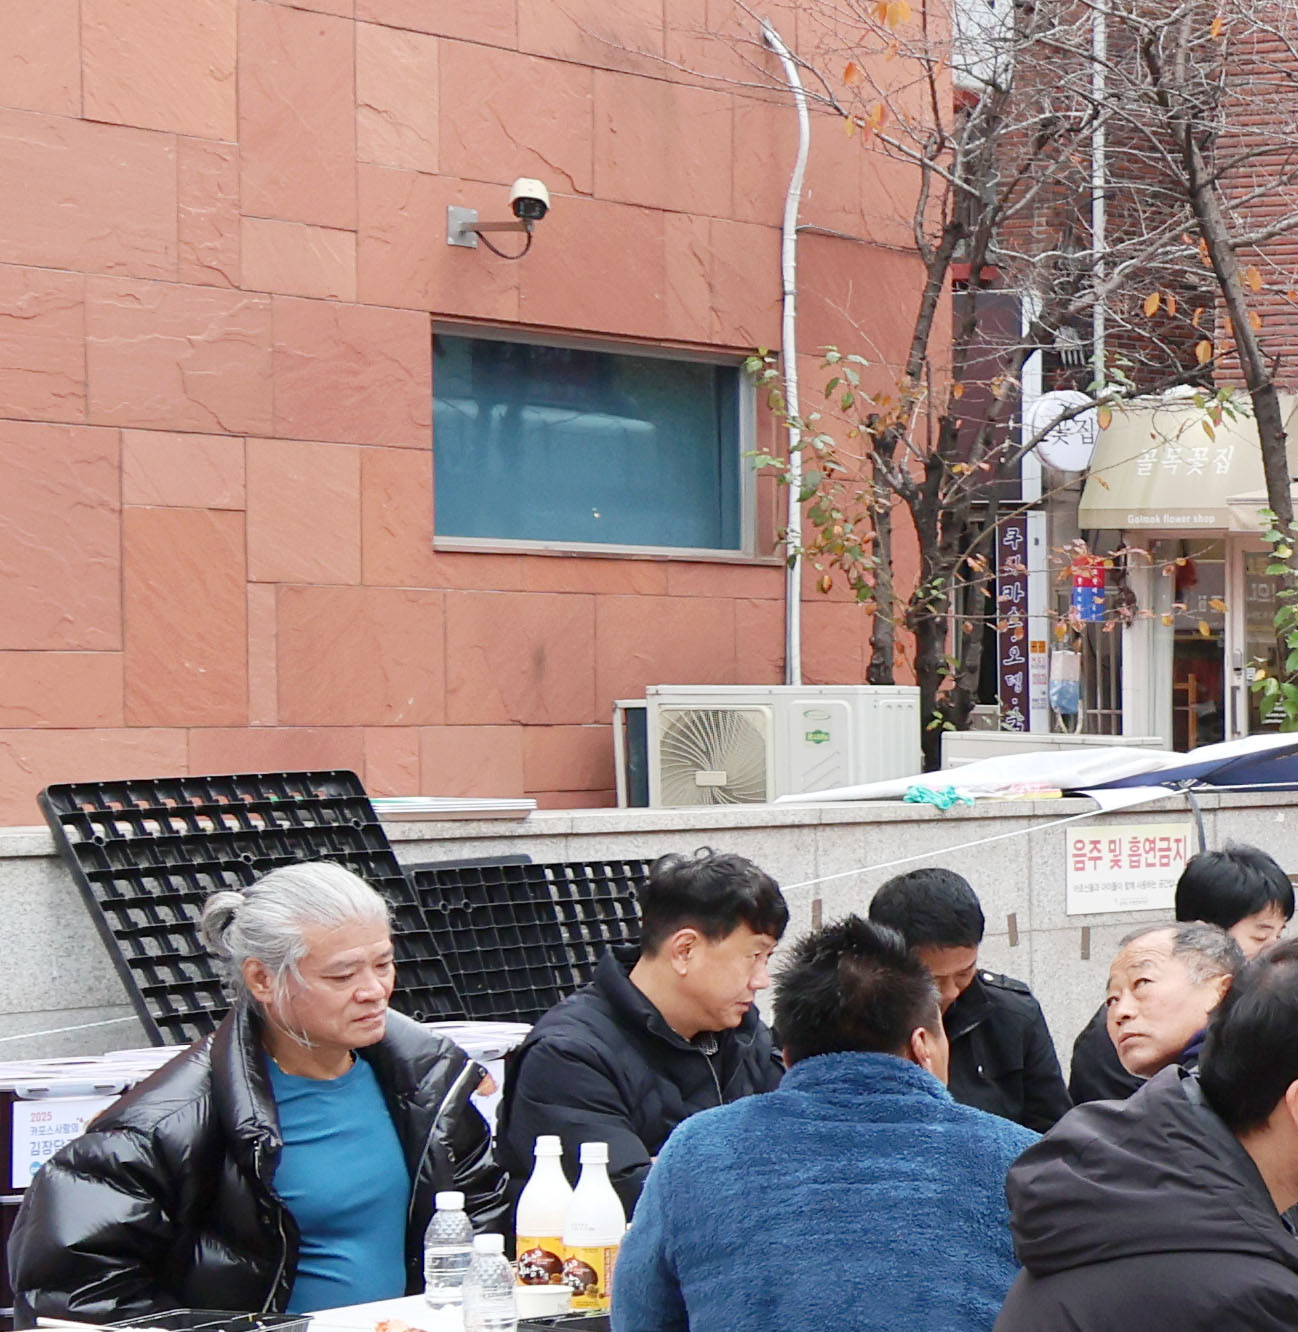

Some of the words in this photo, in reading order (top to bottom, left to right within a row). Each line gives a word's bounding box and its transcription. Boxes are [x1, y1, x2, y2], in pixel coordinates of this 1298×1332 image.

[1128, 513, 1161, 525] Golmok
[1163, 513, 1191, 525] flower
[1193, 513, 1216, 527] shop
[1072, 839, 1103, 872] 음주
[1108, 837, 1122, 870] 및
[1128, 835, 1188, 869] 흡연금지
[31, 1112, 52, 1122] 2025
